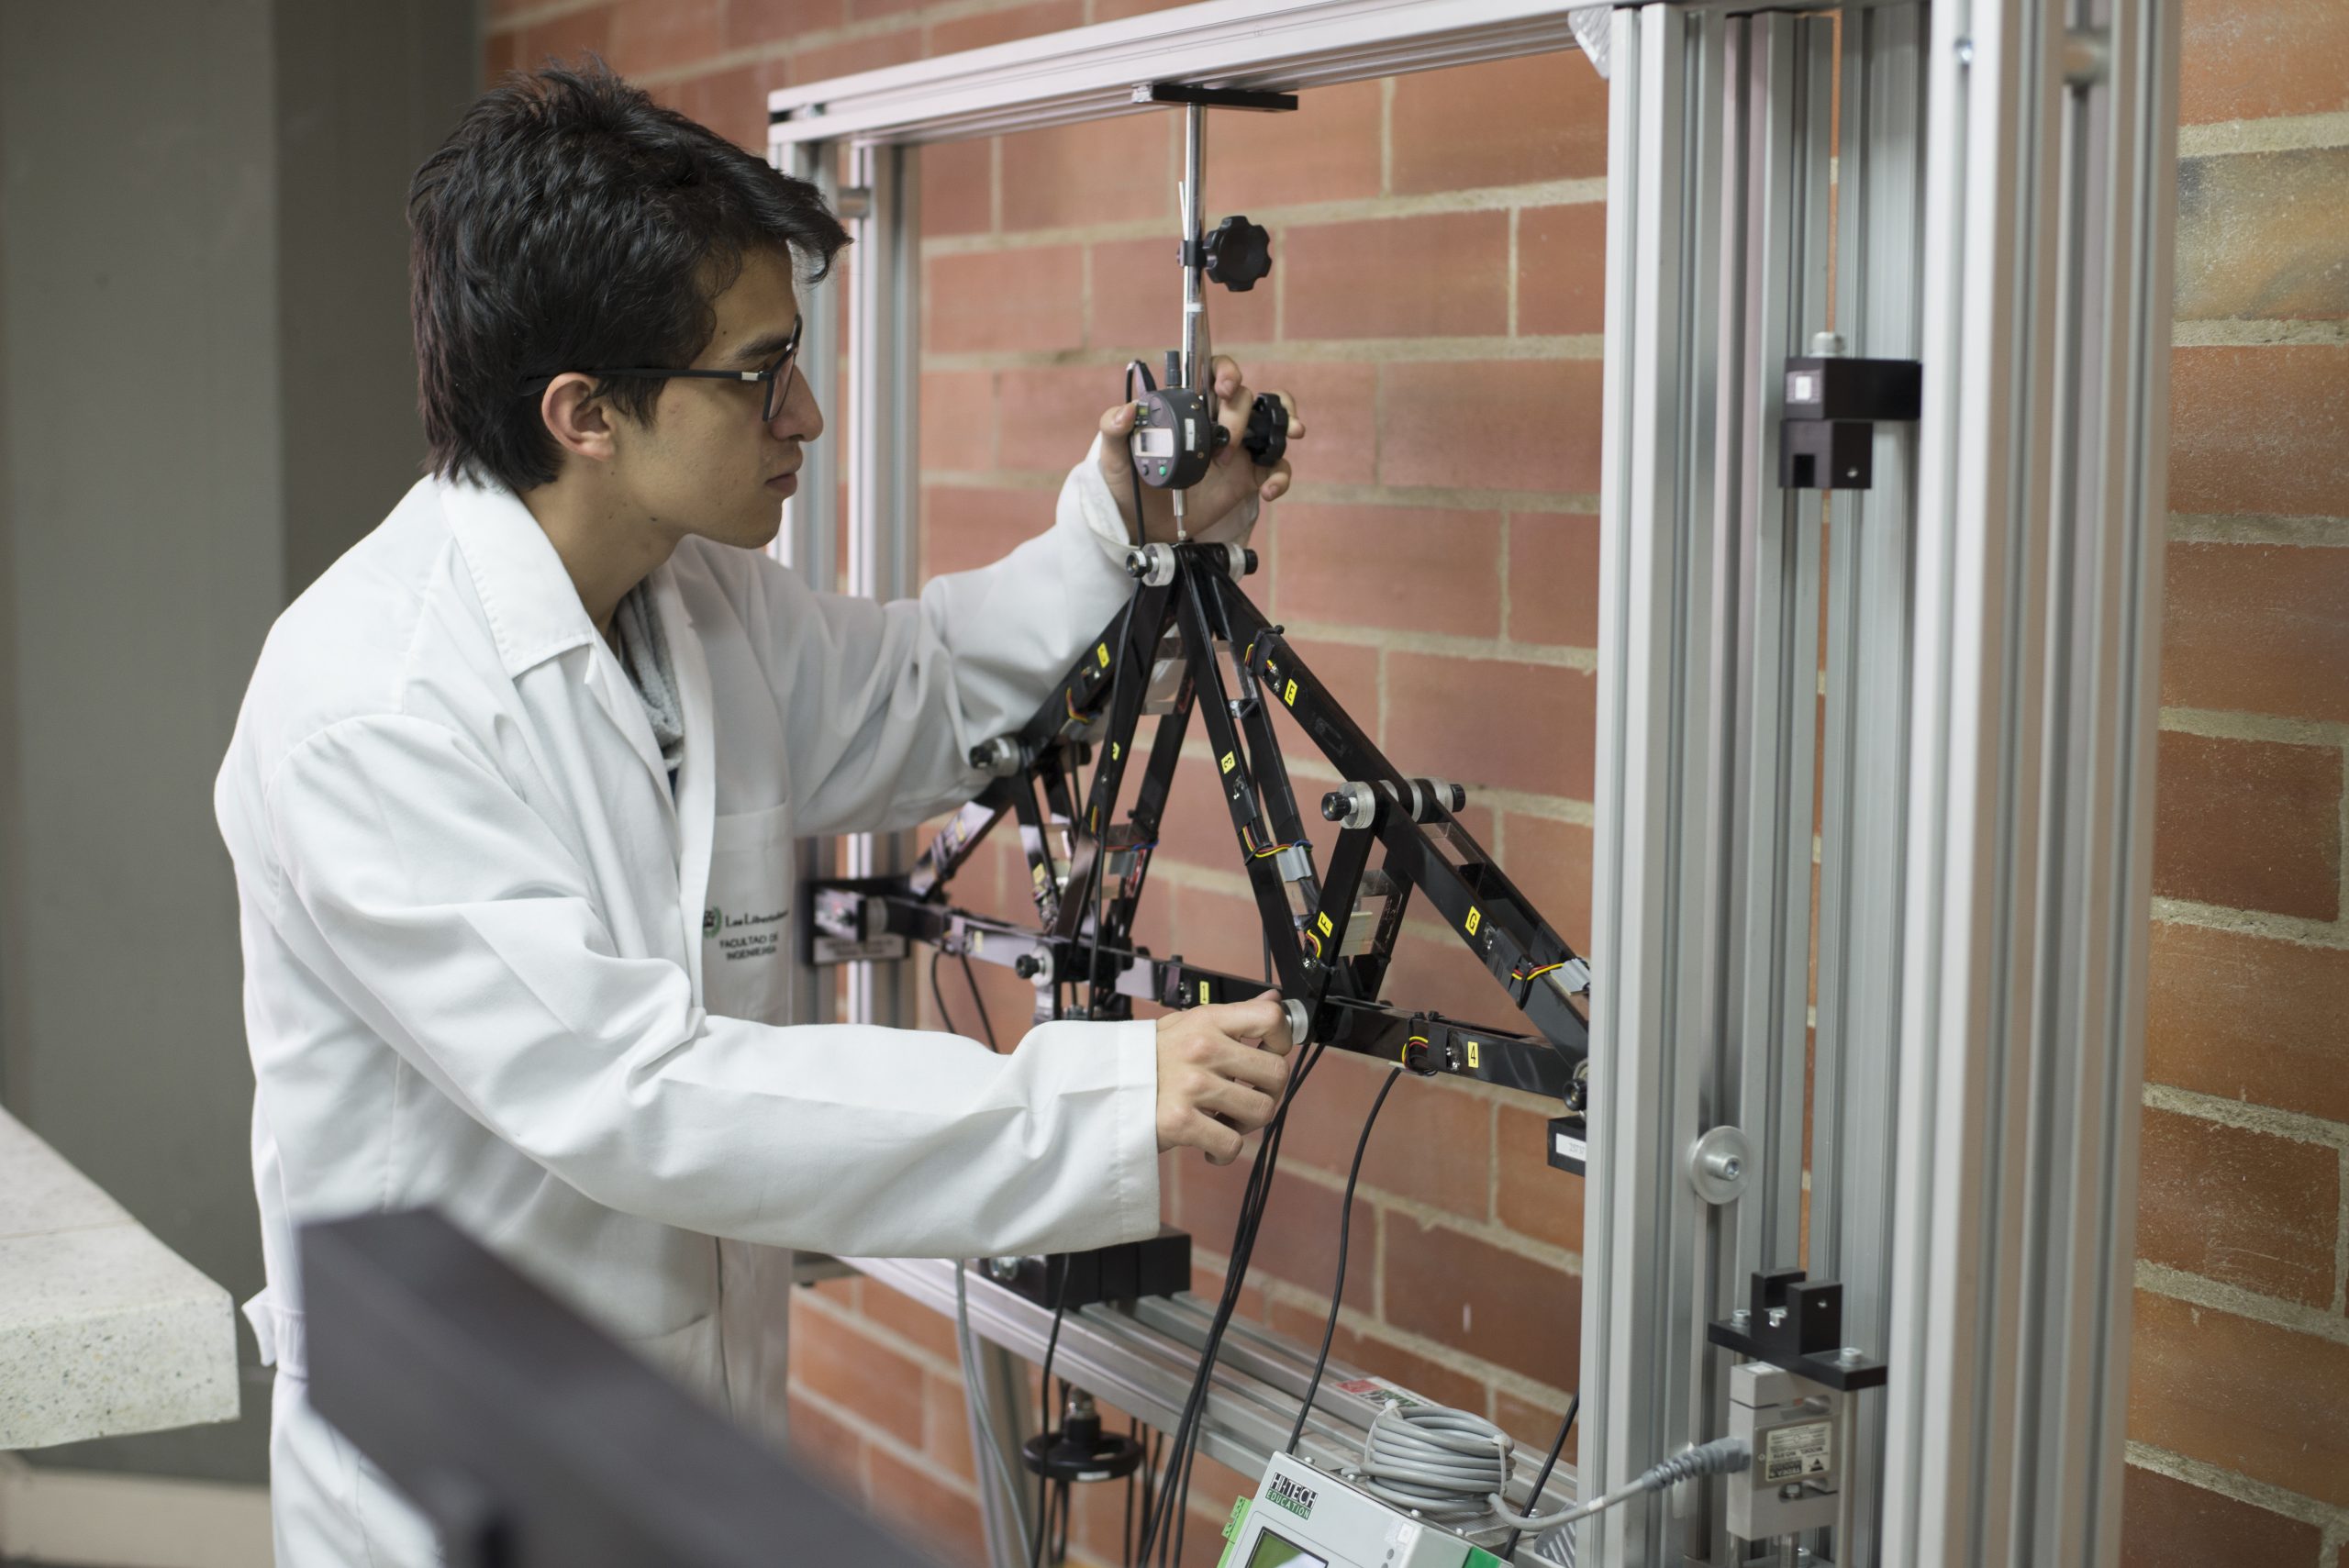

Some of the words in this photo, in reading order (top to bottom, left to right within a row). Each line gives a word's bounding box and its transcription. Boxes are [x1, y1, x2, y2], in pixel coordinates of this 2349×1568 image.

[1286, 684, 1295, 701] E
[1223, 757, 1232, 769] 3
[1320, 917, 1330, 931] F
[1469, 912, 1477, 929] G
[719, 935, 768, 949] FACULTAD
[1470, 1044, 1476, 1064] 4
[1266, 1489, 1310, 1519] EDUCATION
